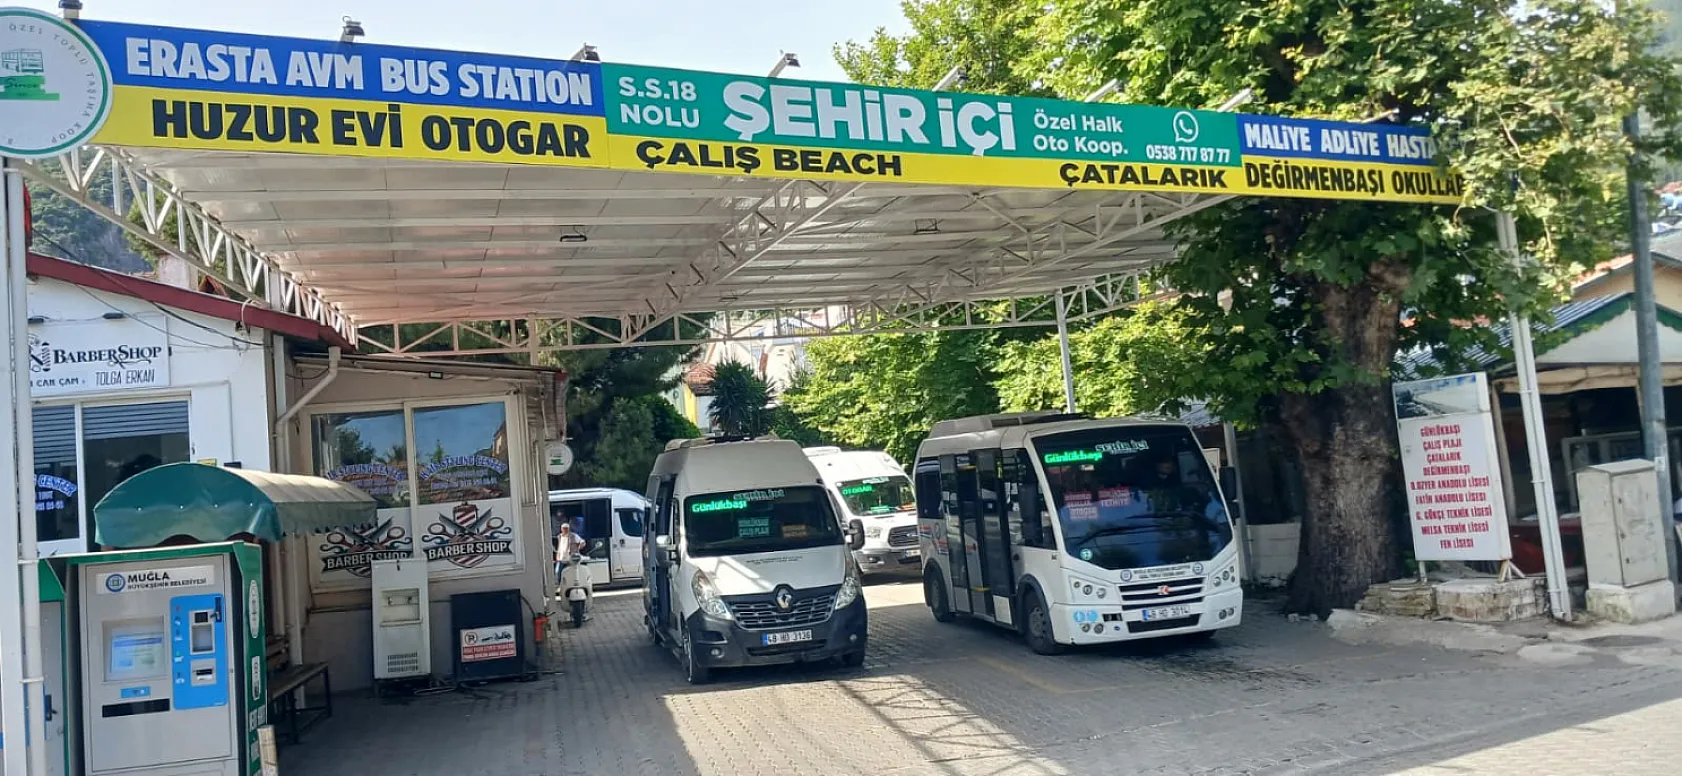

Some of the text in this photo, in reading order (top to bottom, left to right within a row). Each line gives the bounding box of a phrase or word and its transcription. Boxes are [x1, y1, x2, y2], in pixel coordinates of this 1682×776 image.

[126, 38, 592, 106] ERASTA AVM BUS STATION
[618, 76, 700, 128] S.S.18 NOLU
[152, 99, 591, 158] HUZUR EVİ OTOGAR
[1033, 107, 1123, 134] Özel Halk
[636, 140, 902, 176] ÇALIŞ BEACH
[1033, 133, 1129, 157] Oto Koop.
[1146, 144, 1230, 163] 0538 717 87 77
[1059, 163, 1227, 188] ÇATALARIK
[1245, 160, 1384, 197] DEĞİRMENBAŞI
[96, 368, 155, 386] TOLGA ERKAN
[327, 554, 372, 569] BARBER
[428, 542, 508, 560] BARBER SHOP
